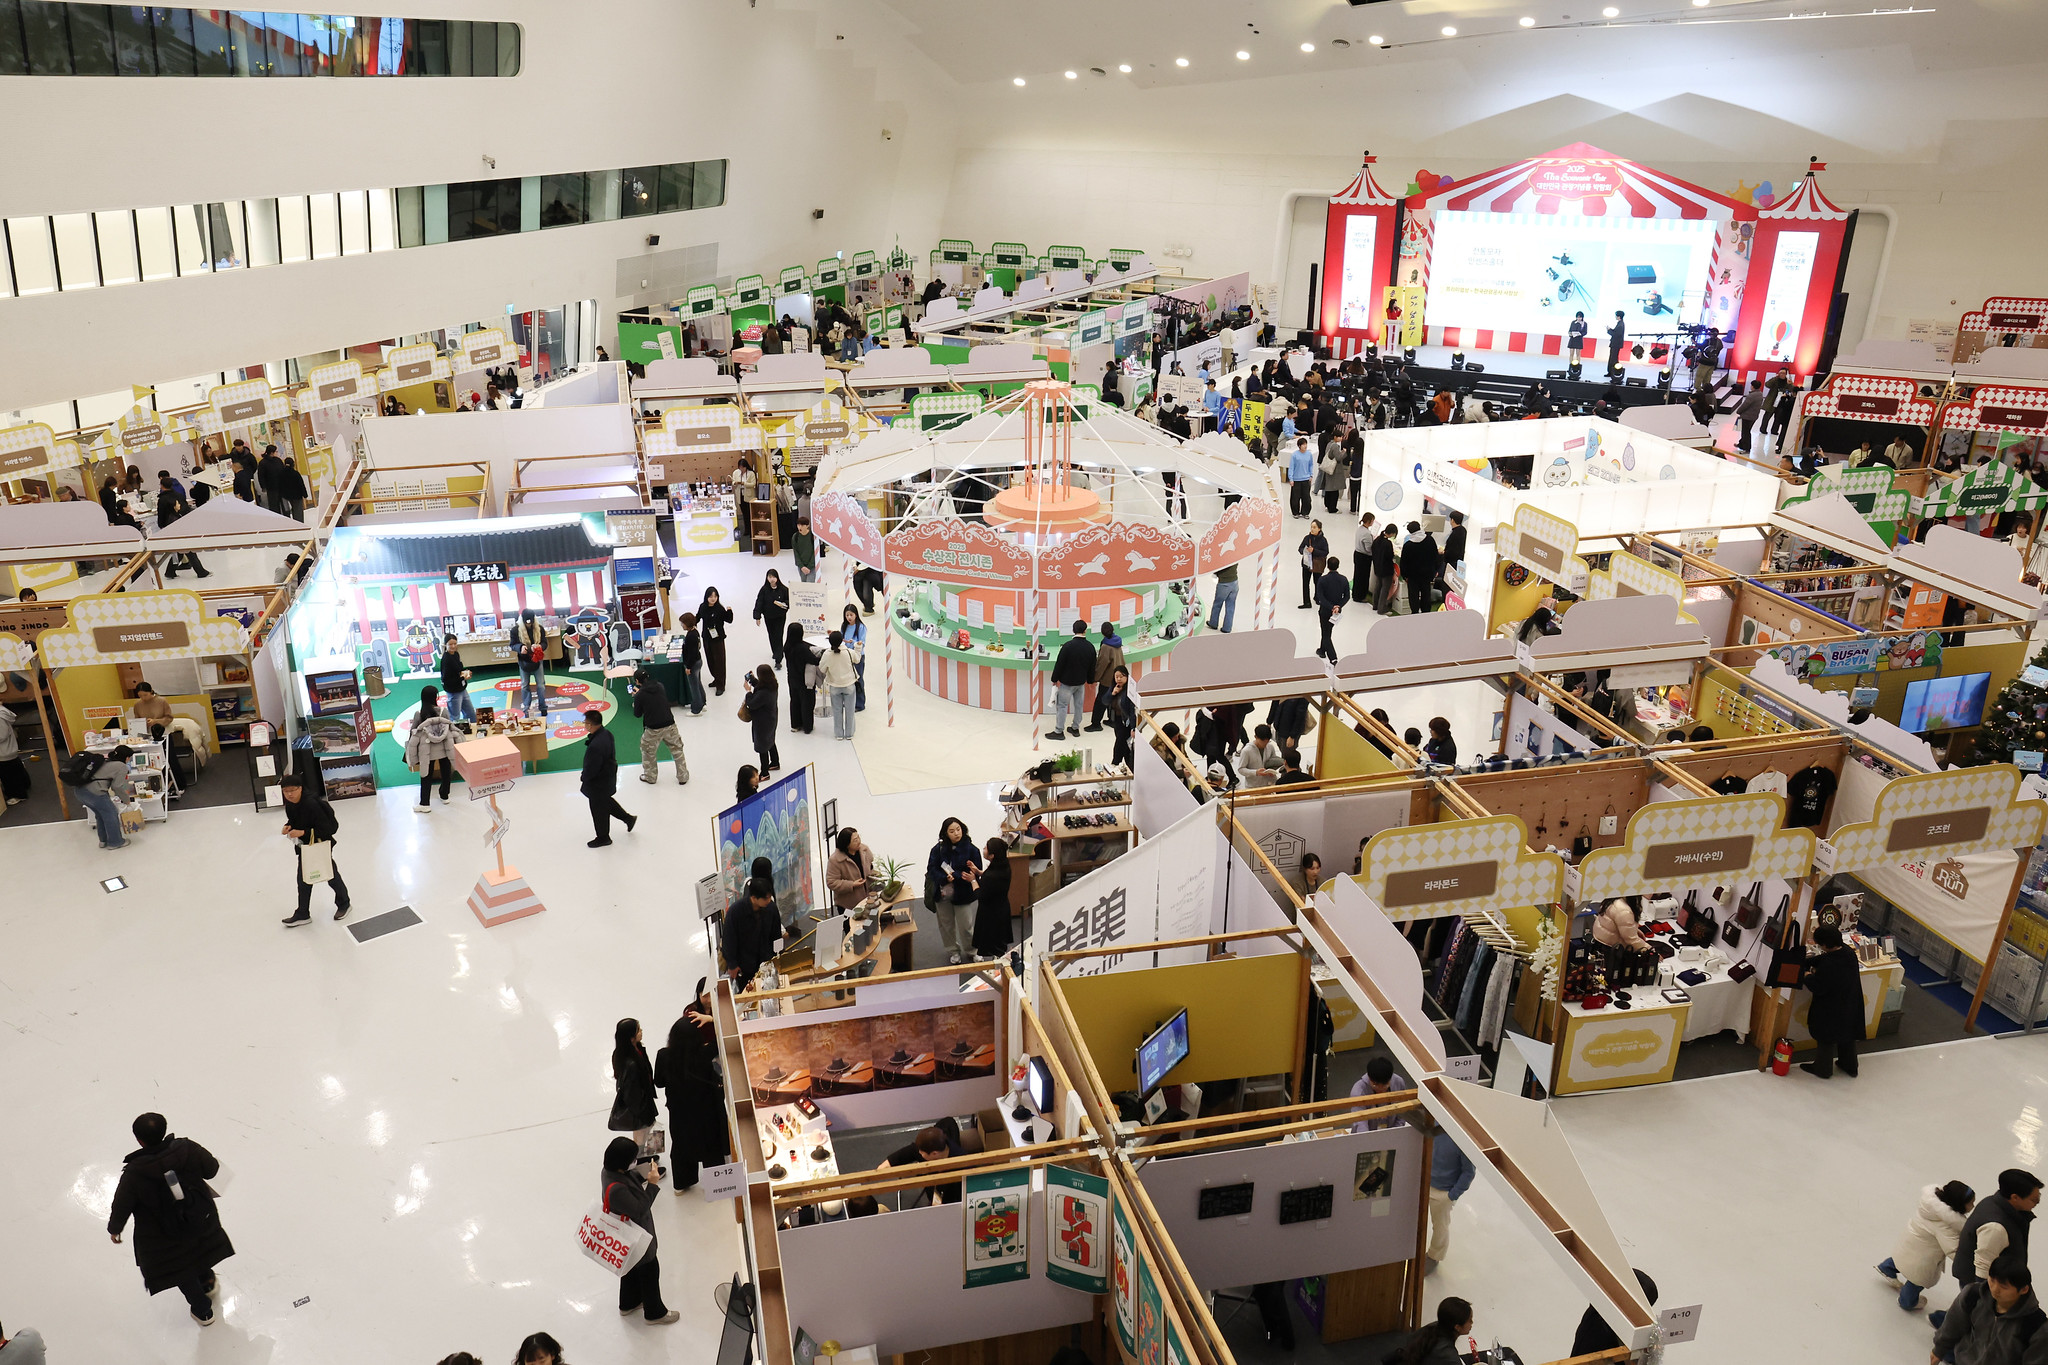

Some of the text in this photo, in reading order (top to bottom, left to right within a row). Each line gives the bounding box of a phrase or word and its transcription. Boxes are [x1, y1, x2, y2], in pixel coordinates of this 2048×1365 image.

[1566, 165, 1585, 173] 2025
[1543, 172, 1560, 181] The
[1536, 182, 1612, 191] 대한민국 관광기념품 박람회
[923, 549, 993, 570] 수상작 전시존
[21, 622, 49, 631] JINDO
[1831, 648, 1869, 661] BUSAN
[1927, 823, 1951, 836] 굿즈런
[1819, 844, 1831, 854] D-03
[1673, 851, 1723, 864] 가바시(수인)
[1424, 878, 1459, 891] 라라몬드
[714, 1168, 733, 1178] D-12
[577, 1225, 624, 1270] HUNTERS
[1670, 1311, 1691, 1320] A-10
